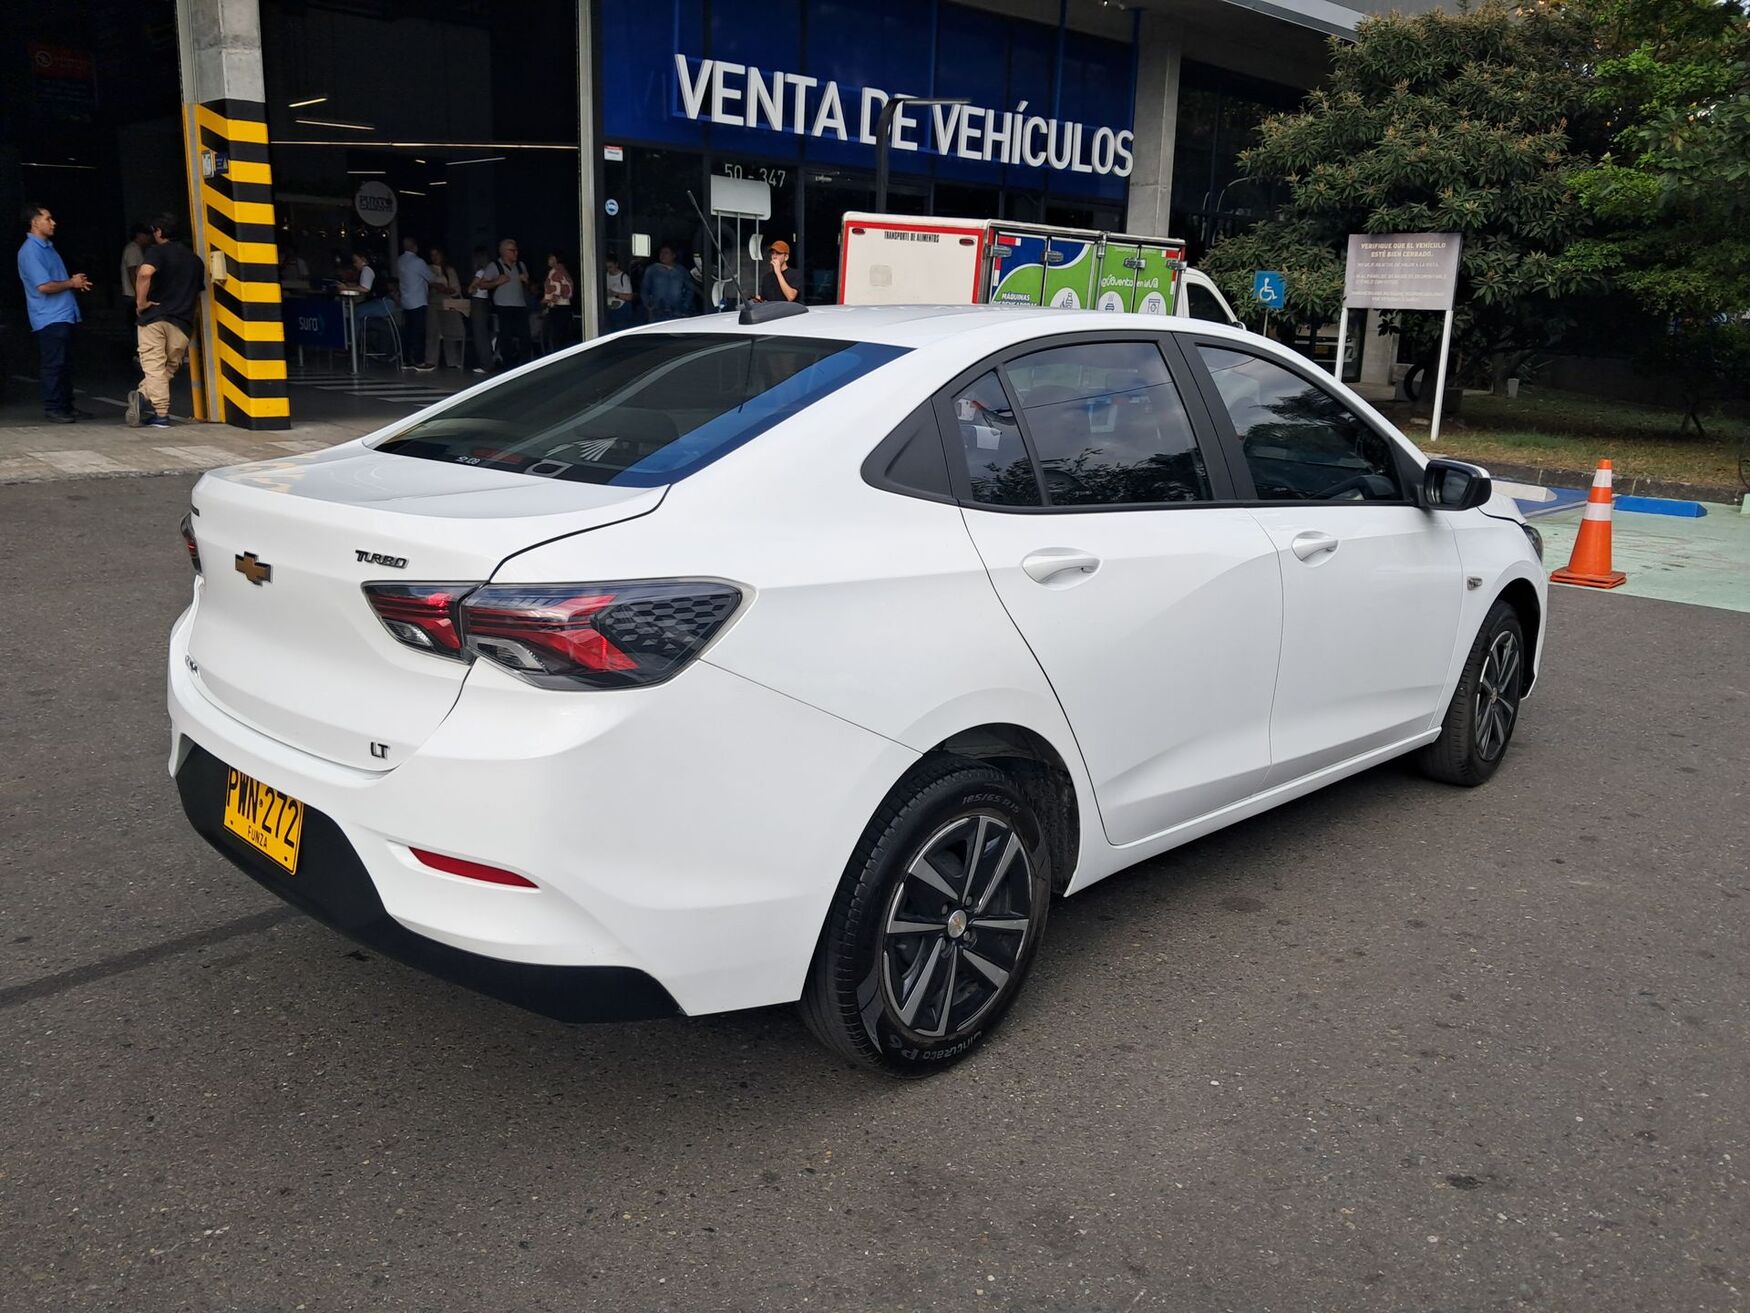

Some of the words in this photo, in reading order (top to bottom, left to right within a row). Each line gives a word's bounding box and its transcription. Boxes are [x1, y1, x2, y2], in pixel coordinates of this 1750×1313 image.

[674, 54, 848, 141] VENTA
[860, 87, 918, 151] DE
[932, 100, 1134, 177] VEHÍCULOS
[759, 168, 786, 188] 347
[355, 549, 409, 569] TURBO
[370, 741, 390, 760] LT
[247, 825, 268, 851] FUNZA
